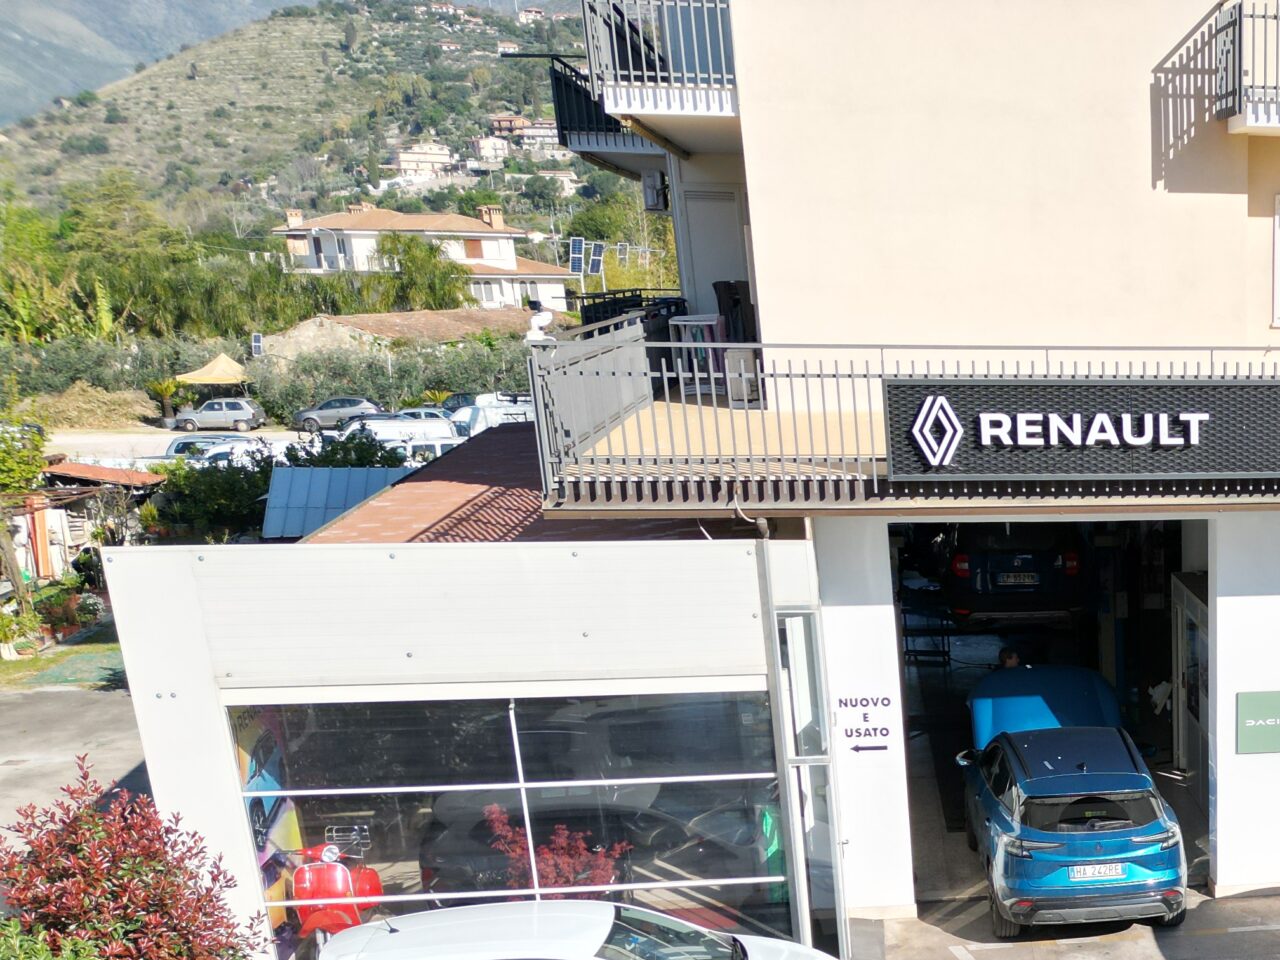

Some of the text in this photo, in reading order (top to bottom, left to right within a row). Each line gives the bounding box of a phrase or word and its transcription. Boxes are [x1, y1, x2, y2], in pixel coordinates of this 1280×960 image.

[979, 412, 1210, 446] RENAULT
[838, 697, 891, 708] NUOVO
[863, 712, 869, 722] E
[844, 727, 890, 738] USATO
